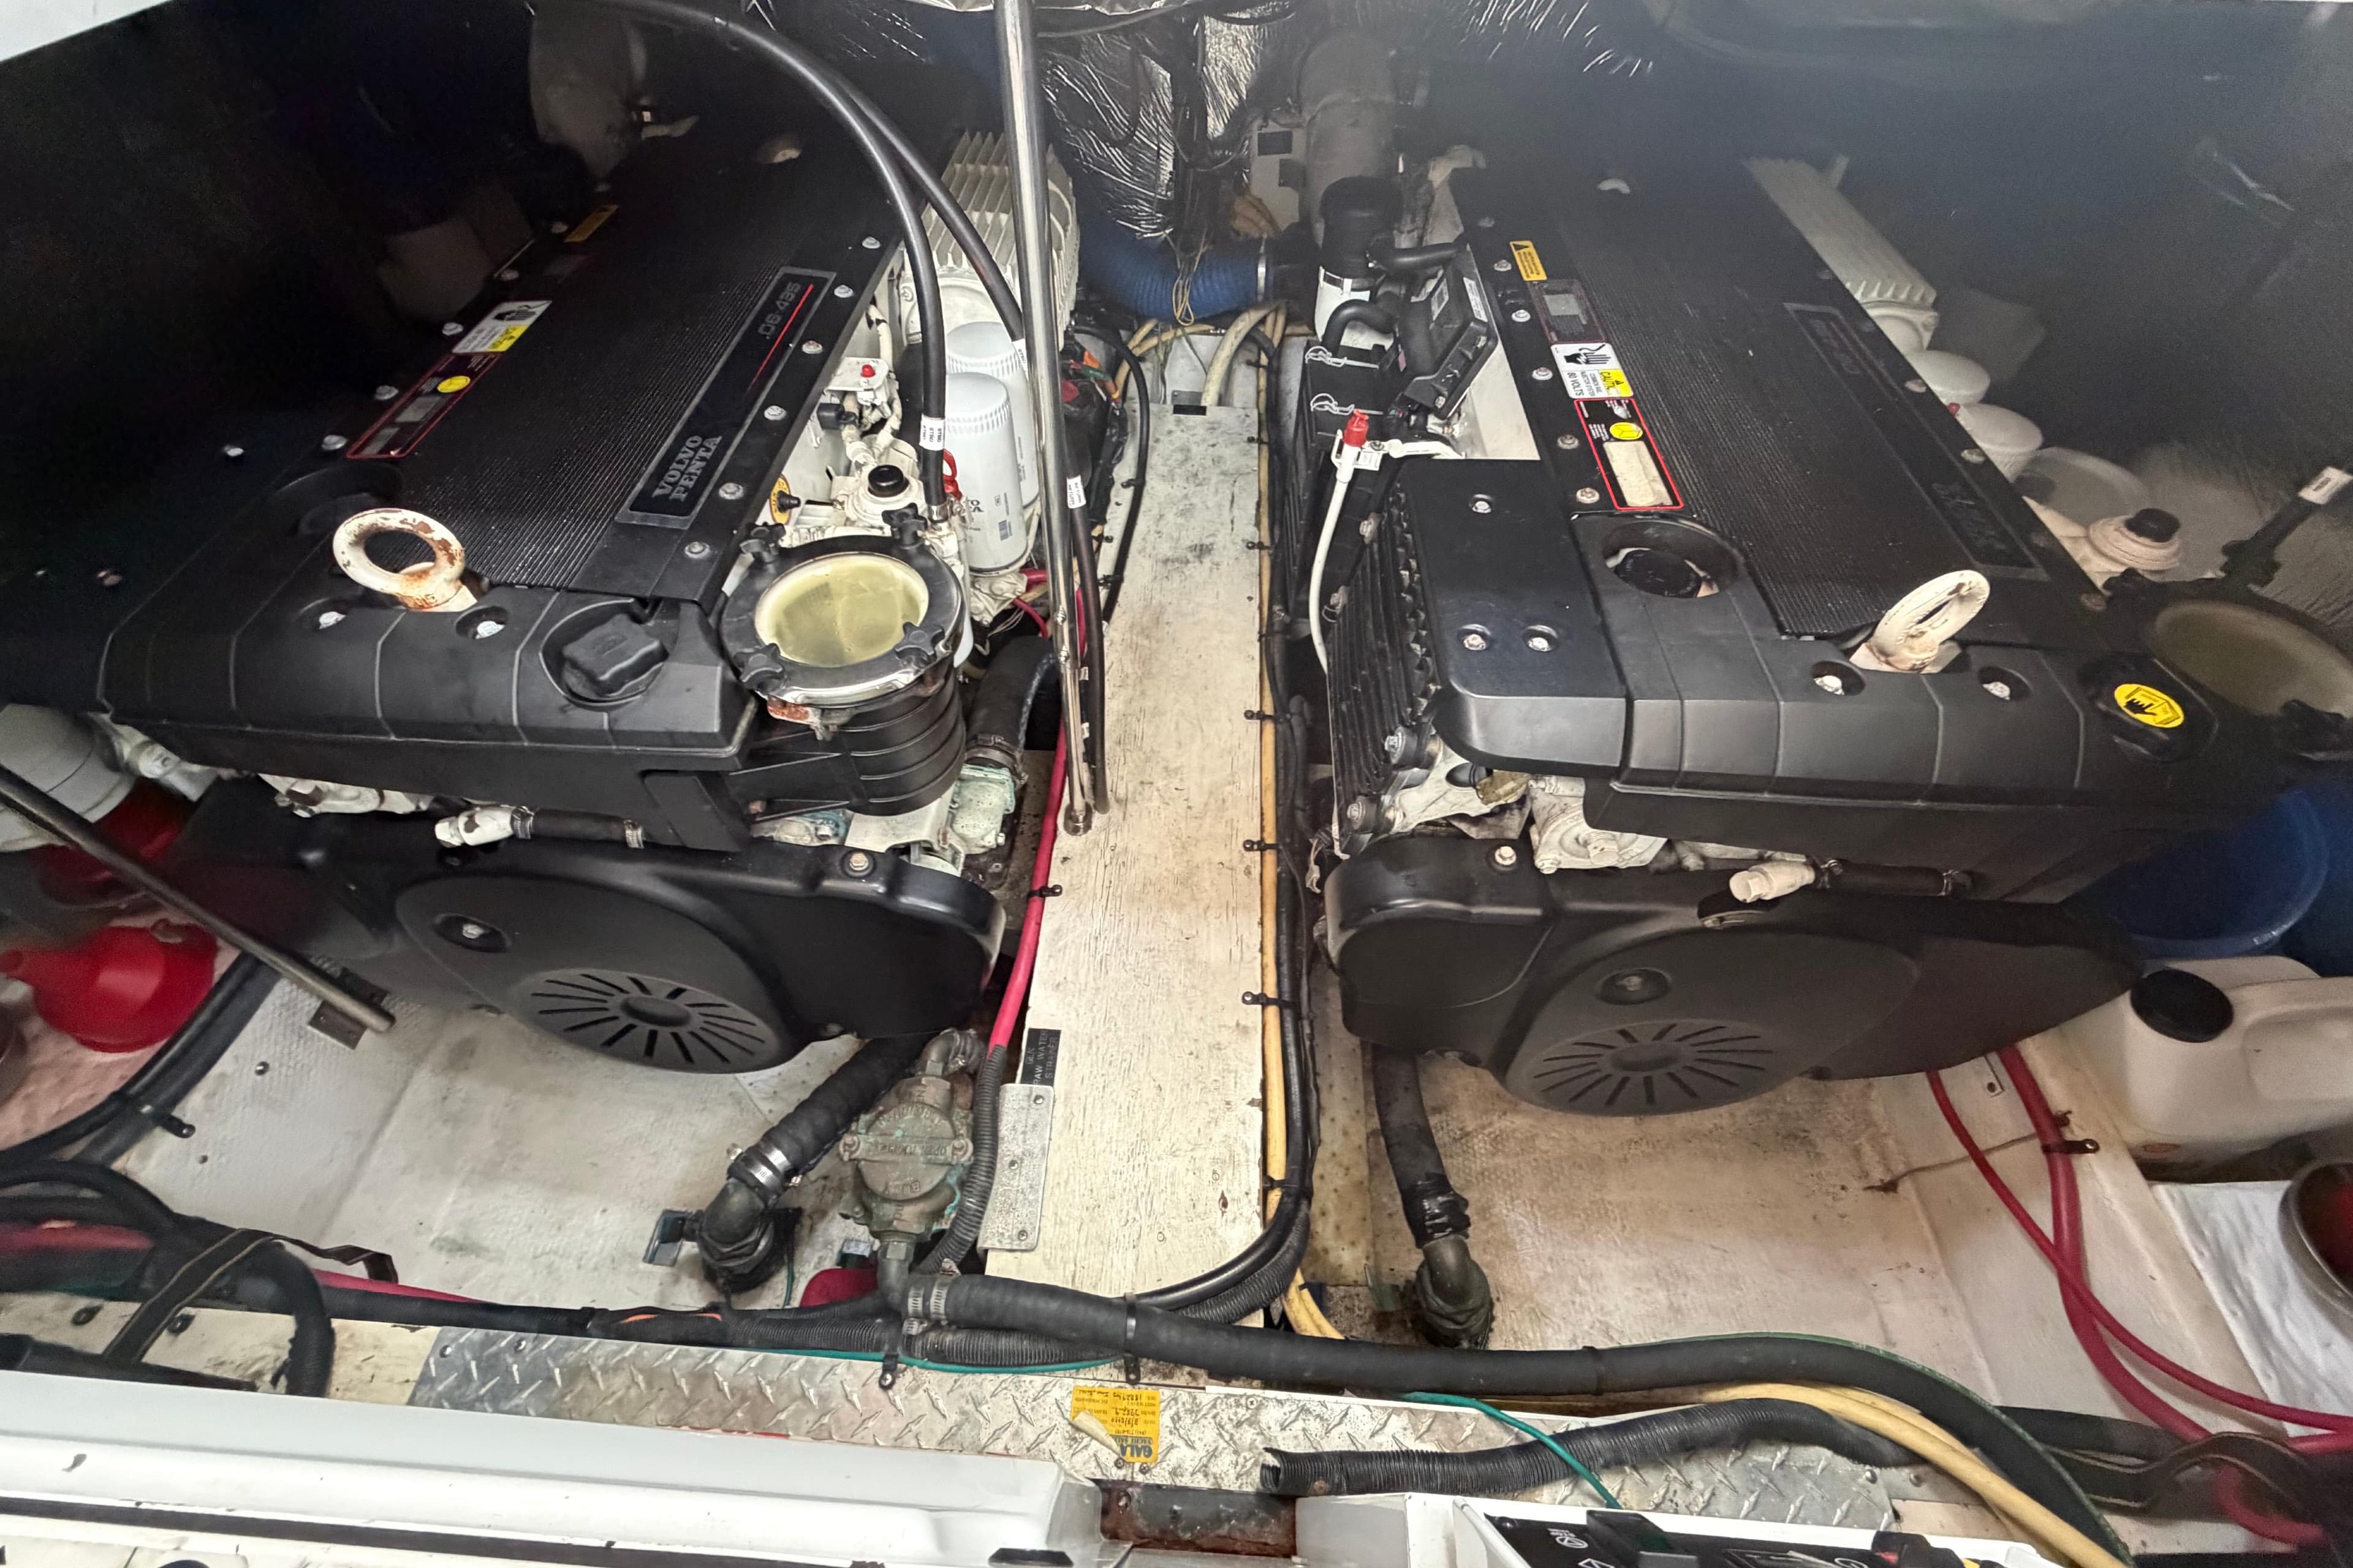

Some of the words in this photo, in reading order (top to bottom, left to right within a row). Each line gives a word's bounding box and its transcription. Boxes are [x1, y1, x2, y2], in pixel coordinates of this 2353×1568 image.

[1571, 379, 1584, 396] VOLTS
[653, 436, 702, 498] VOLVO
[670, 436, 722, 502] PENTA
[1026, 1047, 1034, 1064] GEN
[1037, 1029, 1048, 1061] WATER
[1045, 1037, 1057, 1078] STRAINER
[1033, 1065, 1043, 1085] RAW
[1120, 1444, 1153, 1458] GALA
